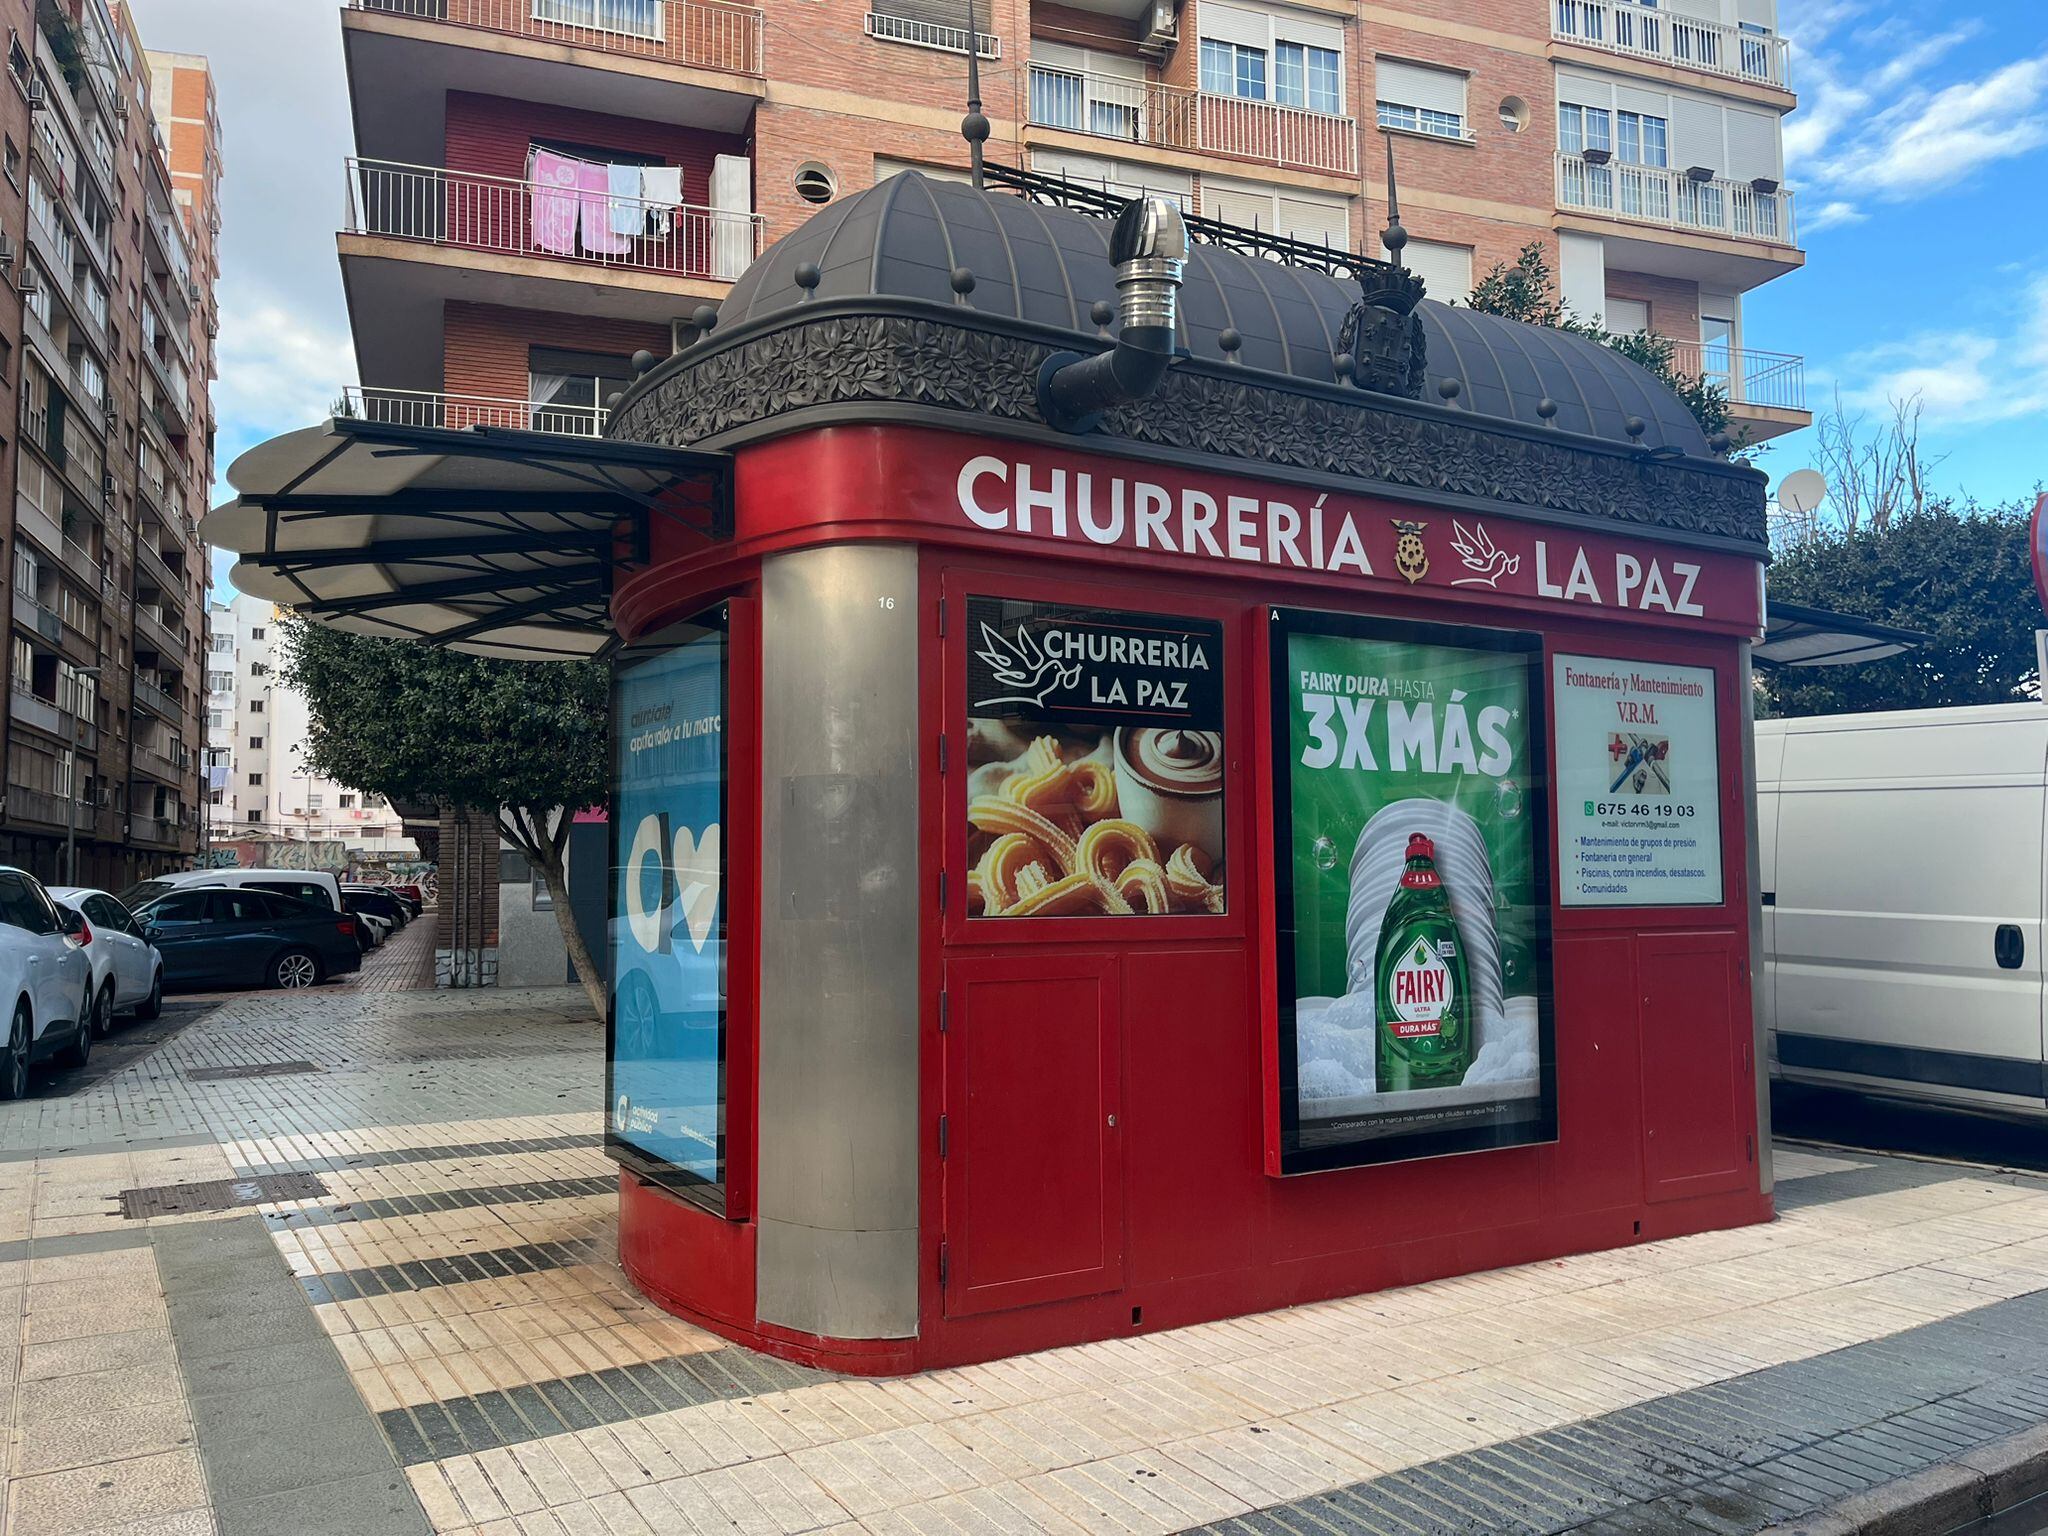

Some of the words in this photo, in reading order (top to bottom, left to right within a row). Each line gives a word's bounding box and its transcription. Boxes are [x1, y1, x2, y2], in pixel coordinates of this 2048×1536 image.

[956, 454, 1374, 576] CHURRERÍA
[1536, 540, 1603, 604] LA
[1616, 553, 1704, 617] PAZ
[878, 596, 895, 610] 16
[1271, 609, 1280, 621] A
[1043, 629, 1209, 671] CHURRERÍA
[1091, 676, 1128, 705] LA
[1137, 678, 1189, 709] PAZ
[1300, 670, 1343, 693] FAIRY
[1345, 675, 1389, 697] DURA
[1393, 679, 1435, 699] HASTA
[1565, 667, 1620, 690] Fontanería
[1621, 677, 1629, 696] y
[1630, 673, 1704, 698] Mantenimiento
[1616, 701, 1659, 725] V.R.M.
[682, 719, 693, 739] tu
[1301, 693, 1379, 771] 3X
[1597, 802, 1627, 816] 675
[1630, 803, 1650, 816] 46
[1654, 803, 1672, 817] 19
[1677, 804, 1695, 817] 03
[1581, 836, 1630, 848] Mantenimiento
[1630, 837, 1639, 847] de
[1640, 839, 1663, 850] grupos
[1663, 837, 1672, 847] de
[1618, 854, 1627, 863] en
[1628, 852, 1653, 864] general
[1582, 867, 1612, 878] Piscinas,
[1613, 869, 1635, 878] contra
[1636, 868, 1668, 879] incendios,
[1582, 883, 1628, 894] Comunidades
[1396, 970, 1445, 1004] FAIRY
[1399, 1024, 1419, 1034] DURA
